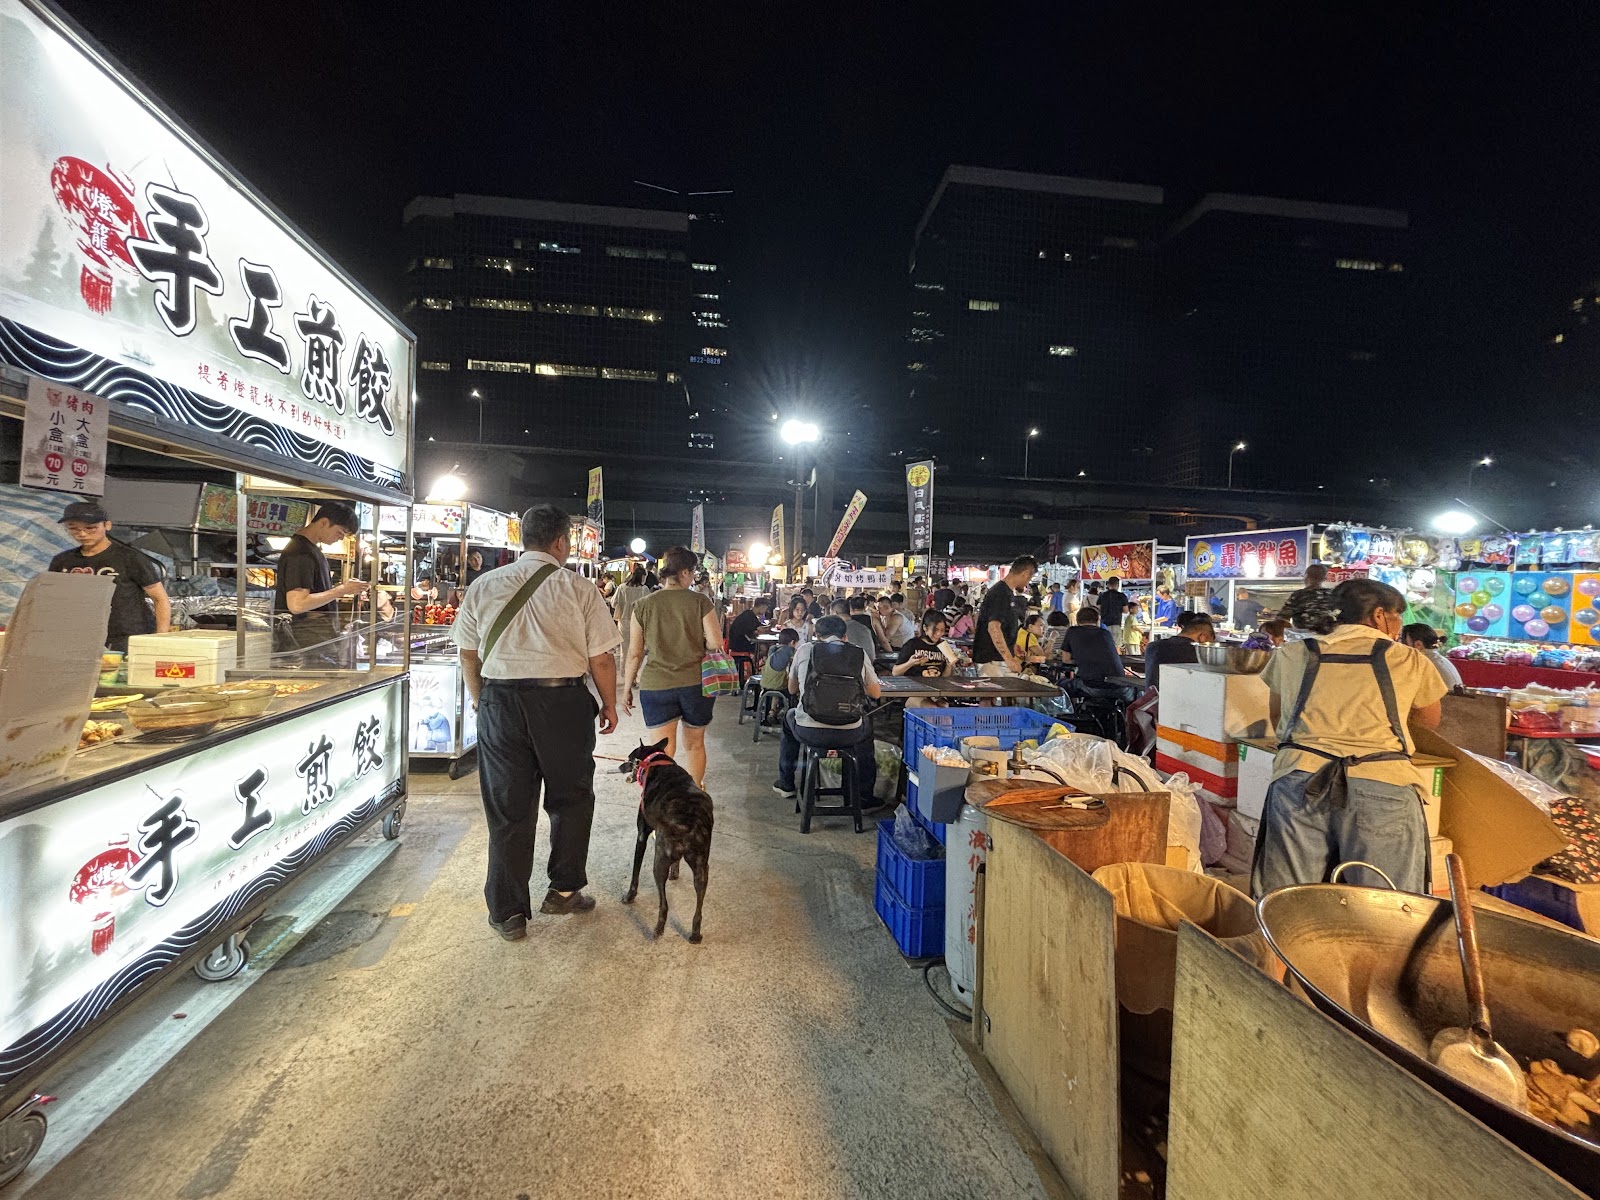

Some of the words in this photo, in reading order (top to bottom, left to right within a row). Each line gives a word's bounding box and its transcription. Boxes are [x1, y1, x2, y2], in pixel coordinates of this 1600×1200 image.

[90, 188, 116, 255] 燈籠
[126, 182, 398, 437] 手工煎餃
[66, 394, 94, 415] 豬肉
[48, 458, 61, 469] 70
[73, 462, 88, 474] 150
[47, 474, 60, 487] 元
[73, 478, 86, 490] 元
[126, 714, 384, 906] 手工煎餃
